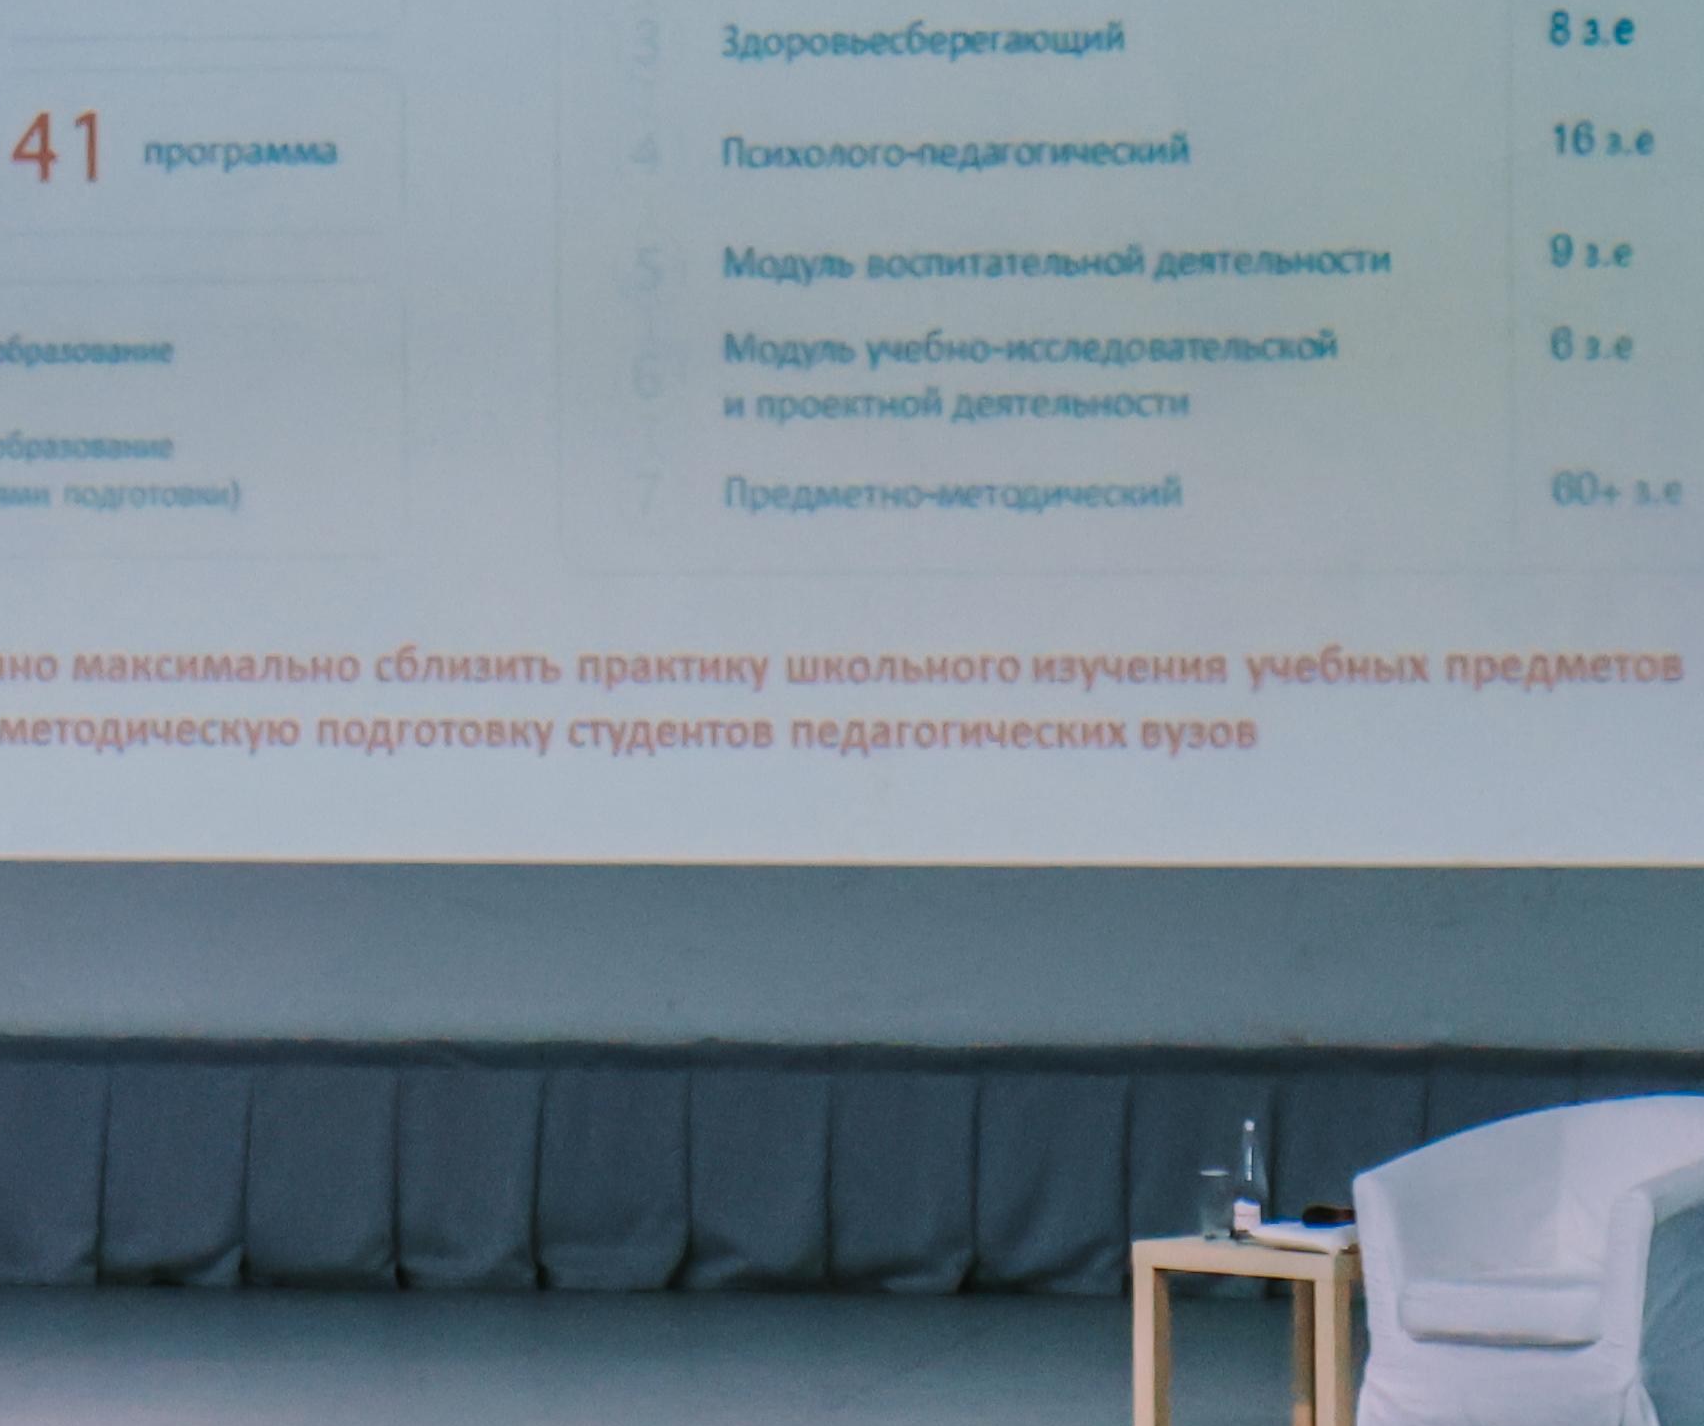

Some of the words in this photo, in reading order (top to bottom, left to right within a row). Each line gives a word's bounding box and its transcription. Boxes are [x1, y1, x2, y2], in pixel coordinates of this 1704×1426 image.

[721, 20, 1126, 64] Здоровьесберегающий
[1548, 9, 1572, 48] 8
[1582, 17, 1636, 47] з.е
[11, 109, 98, 182] 41
[143, 142, 339, 173] программа
[721, 132, 1192, 173] Психолого-педагогический
[1553, 120, 1596, 158] 16
[1605, 130, 1655, 157] з.е
[722, 246, 857, 287] Модуль
[865, 244, 1147, 281] воспитательной
[1152, 249, 1393, 282] деятельности
[1549, 233, 1575, 269] 9
[1584, 242, 1634, 269] з.е
[722, 332, 858, 371] Модуль
[865, 328, 1340, 371] учебно-исследовательской
[1549, 325, 1575, 363] 6
[1584, 335, 1634, 362] з.е
[722, 396, 746, 419] и
[755, 386, 944, 425] проектной
[949, 392, 1191, 424] деятельности
[723, 475, 1184, 515] Предметно-методический
[1634, 479, 1684, 508] з.е
[72, 652, 361, 683] максимально
[373, 642, 562, 684] сблизить
[576, 652, 770, 692] практику
[784, 652, 1022, 685] школьного
[1031, 653, 1228, 692] изучения
[1244, 642, 1430, 691] учебных
[1444, 650, 1684, 692] предметов
[316, 716, 555, 757] подготовку
[566, 716, 774, 757] студентов
[789, 717, 1128, 757] педагогических
[1139, 717, 1258, 757] вузов
